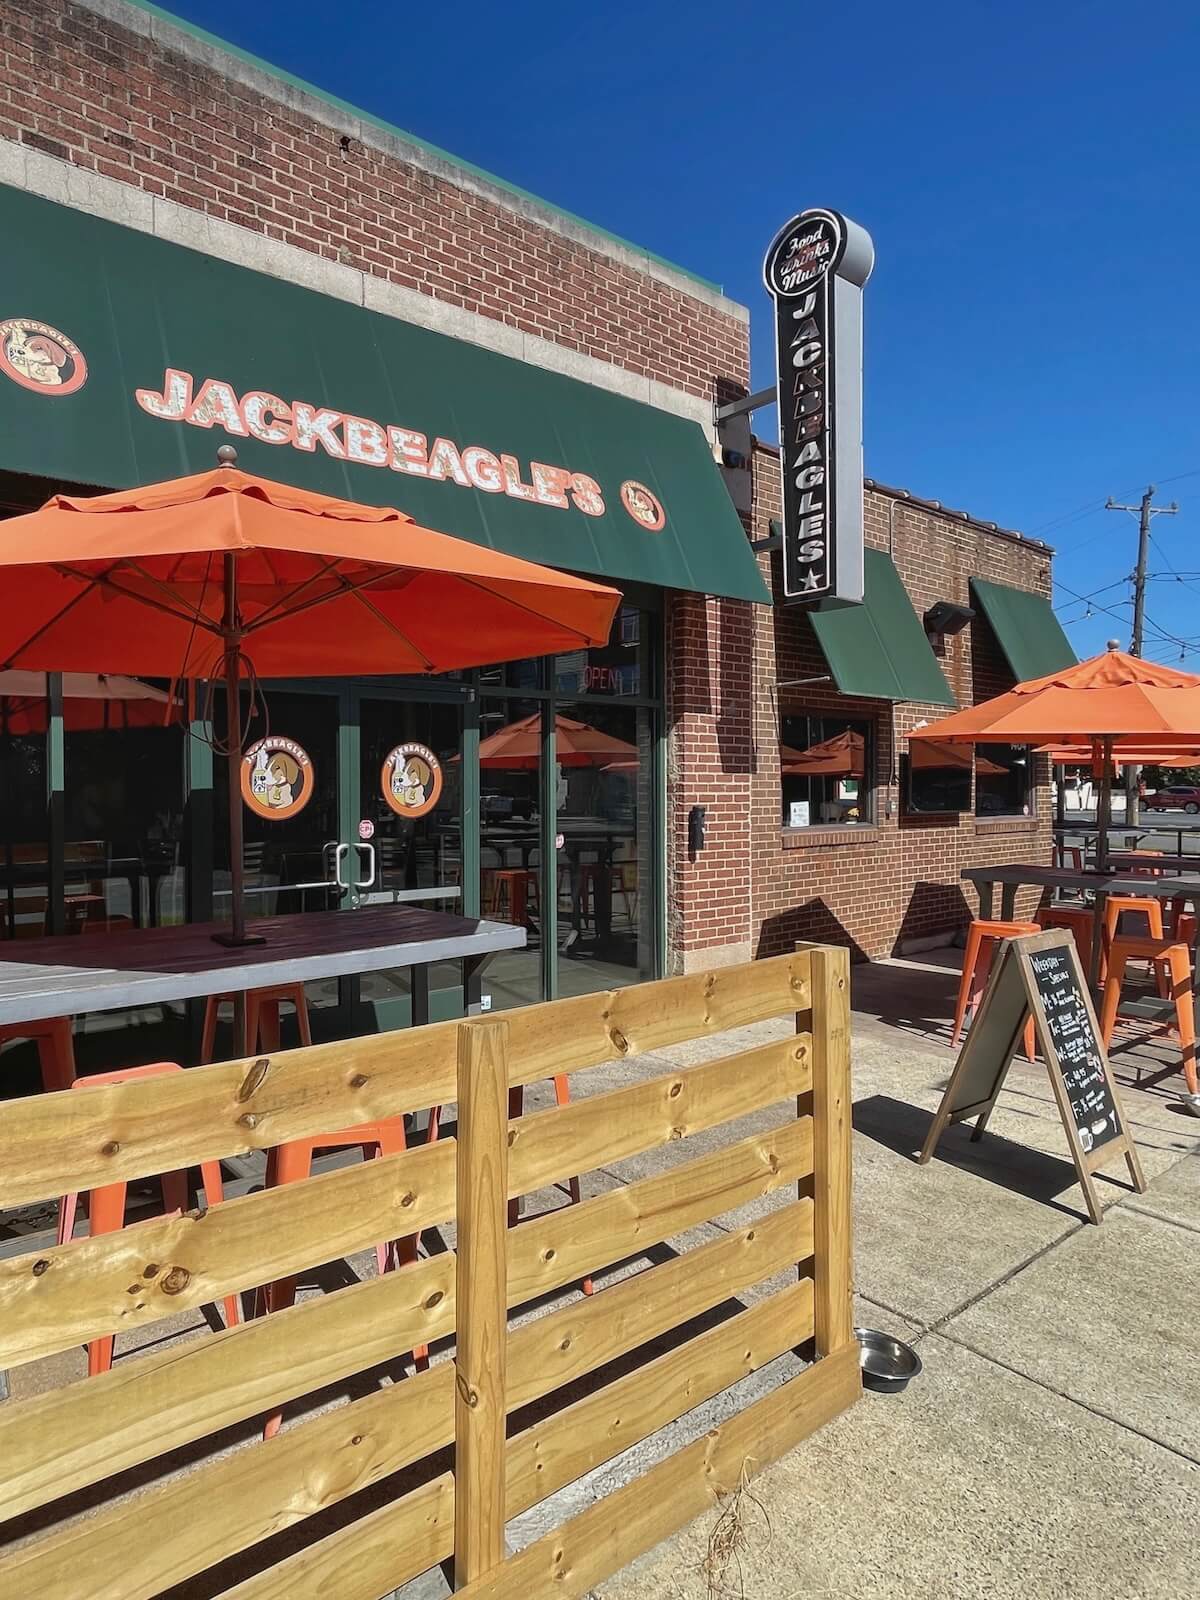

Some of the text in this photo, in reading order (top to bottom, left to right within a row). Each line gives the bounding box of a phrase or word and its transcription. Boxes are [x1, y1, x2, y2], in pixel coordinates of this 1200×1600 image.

[787, 223, 824, 259] Food
[782, 257, 830, 291] Music
[135, 367, 606, 517] JACKBEAGLE'S
[583, 666, 616, 689] OPEN
